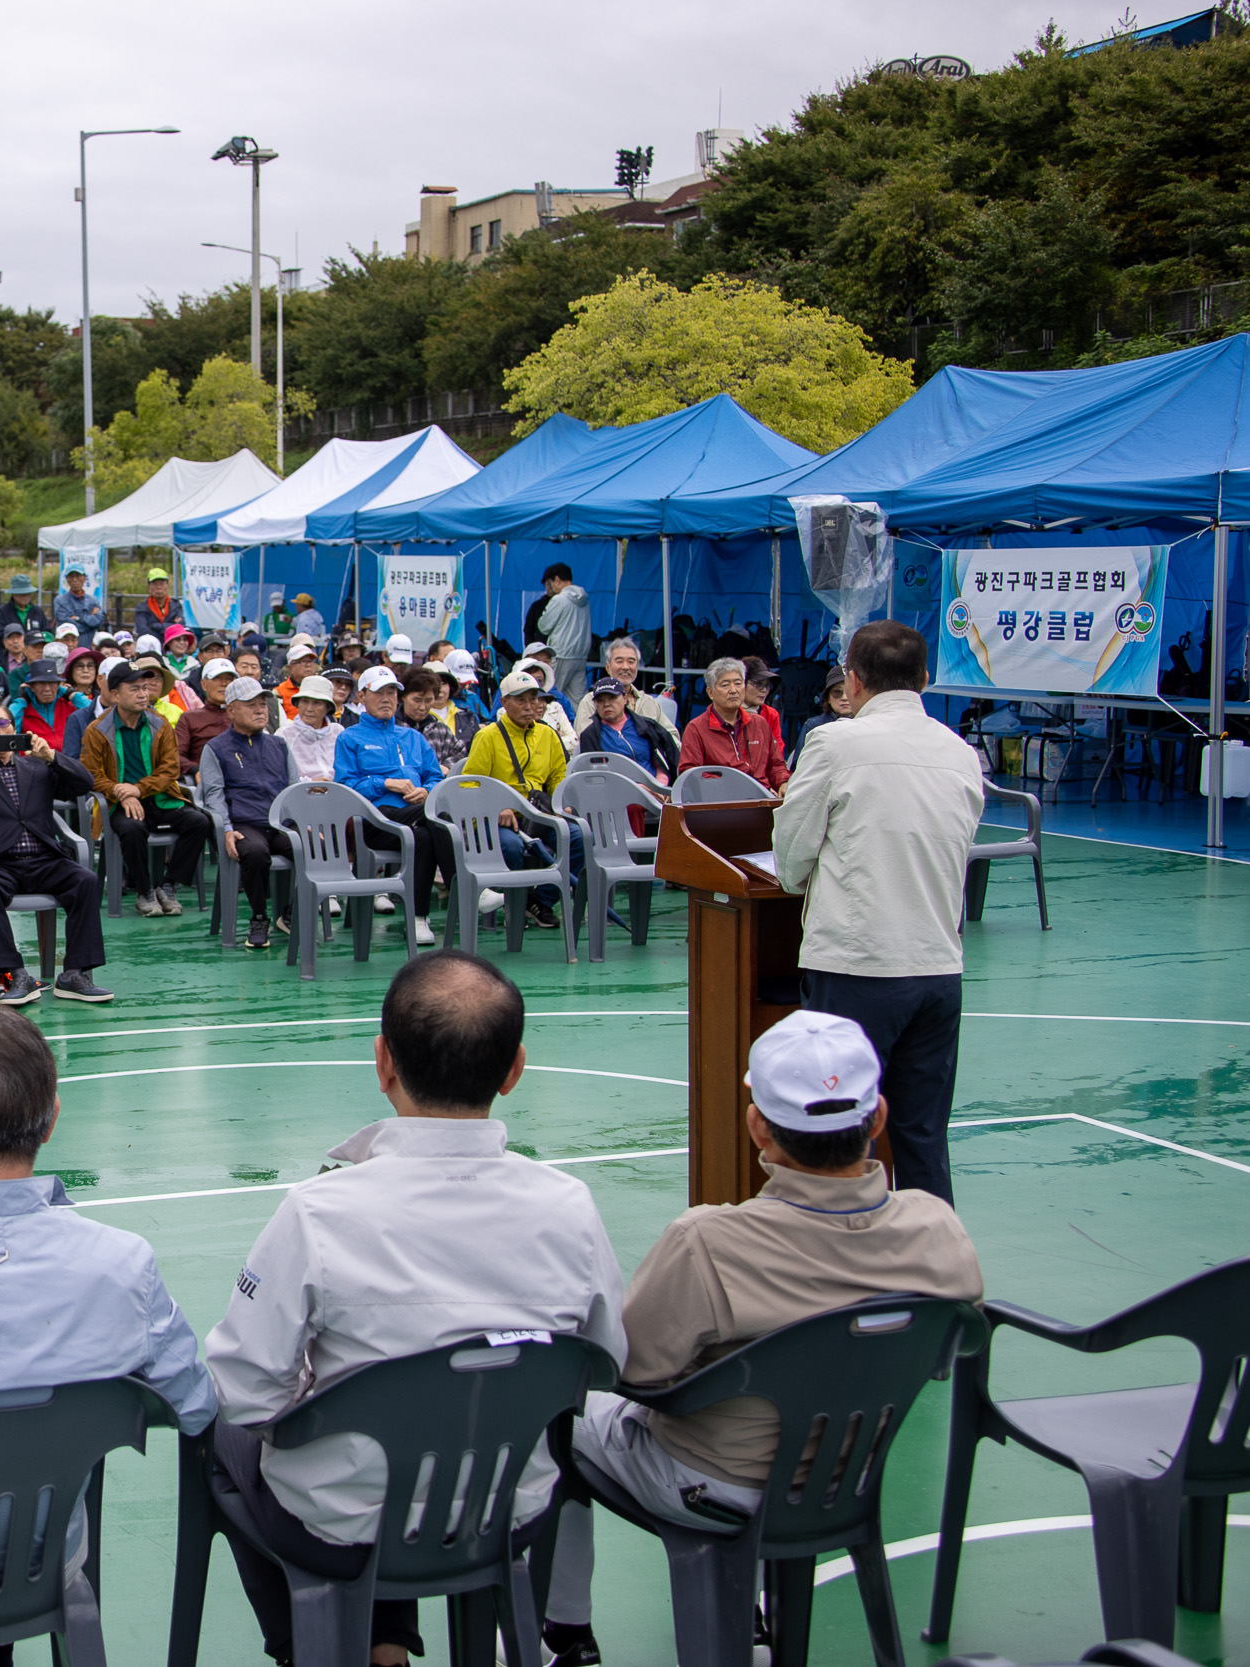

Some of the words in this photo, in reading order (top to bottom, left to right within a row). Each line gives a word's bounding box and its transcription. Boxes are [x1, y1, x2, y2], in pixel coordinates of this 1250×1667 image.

[928, 59, 964, 77] Arai
[390, 570, 448, 586] 광진구파크골프협회
[974, 570, 1126, 593] 광진구파크골프협회
[399, 596, 437, 618] 용마클럽
[996, 609, 1095, 642] 평강클럽
